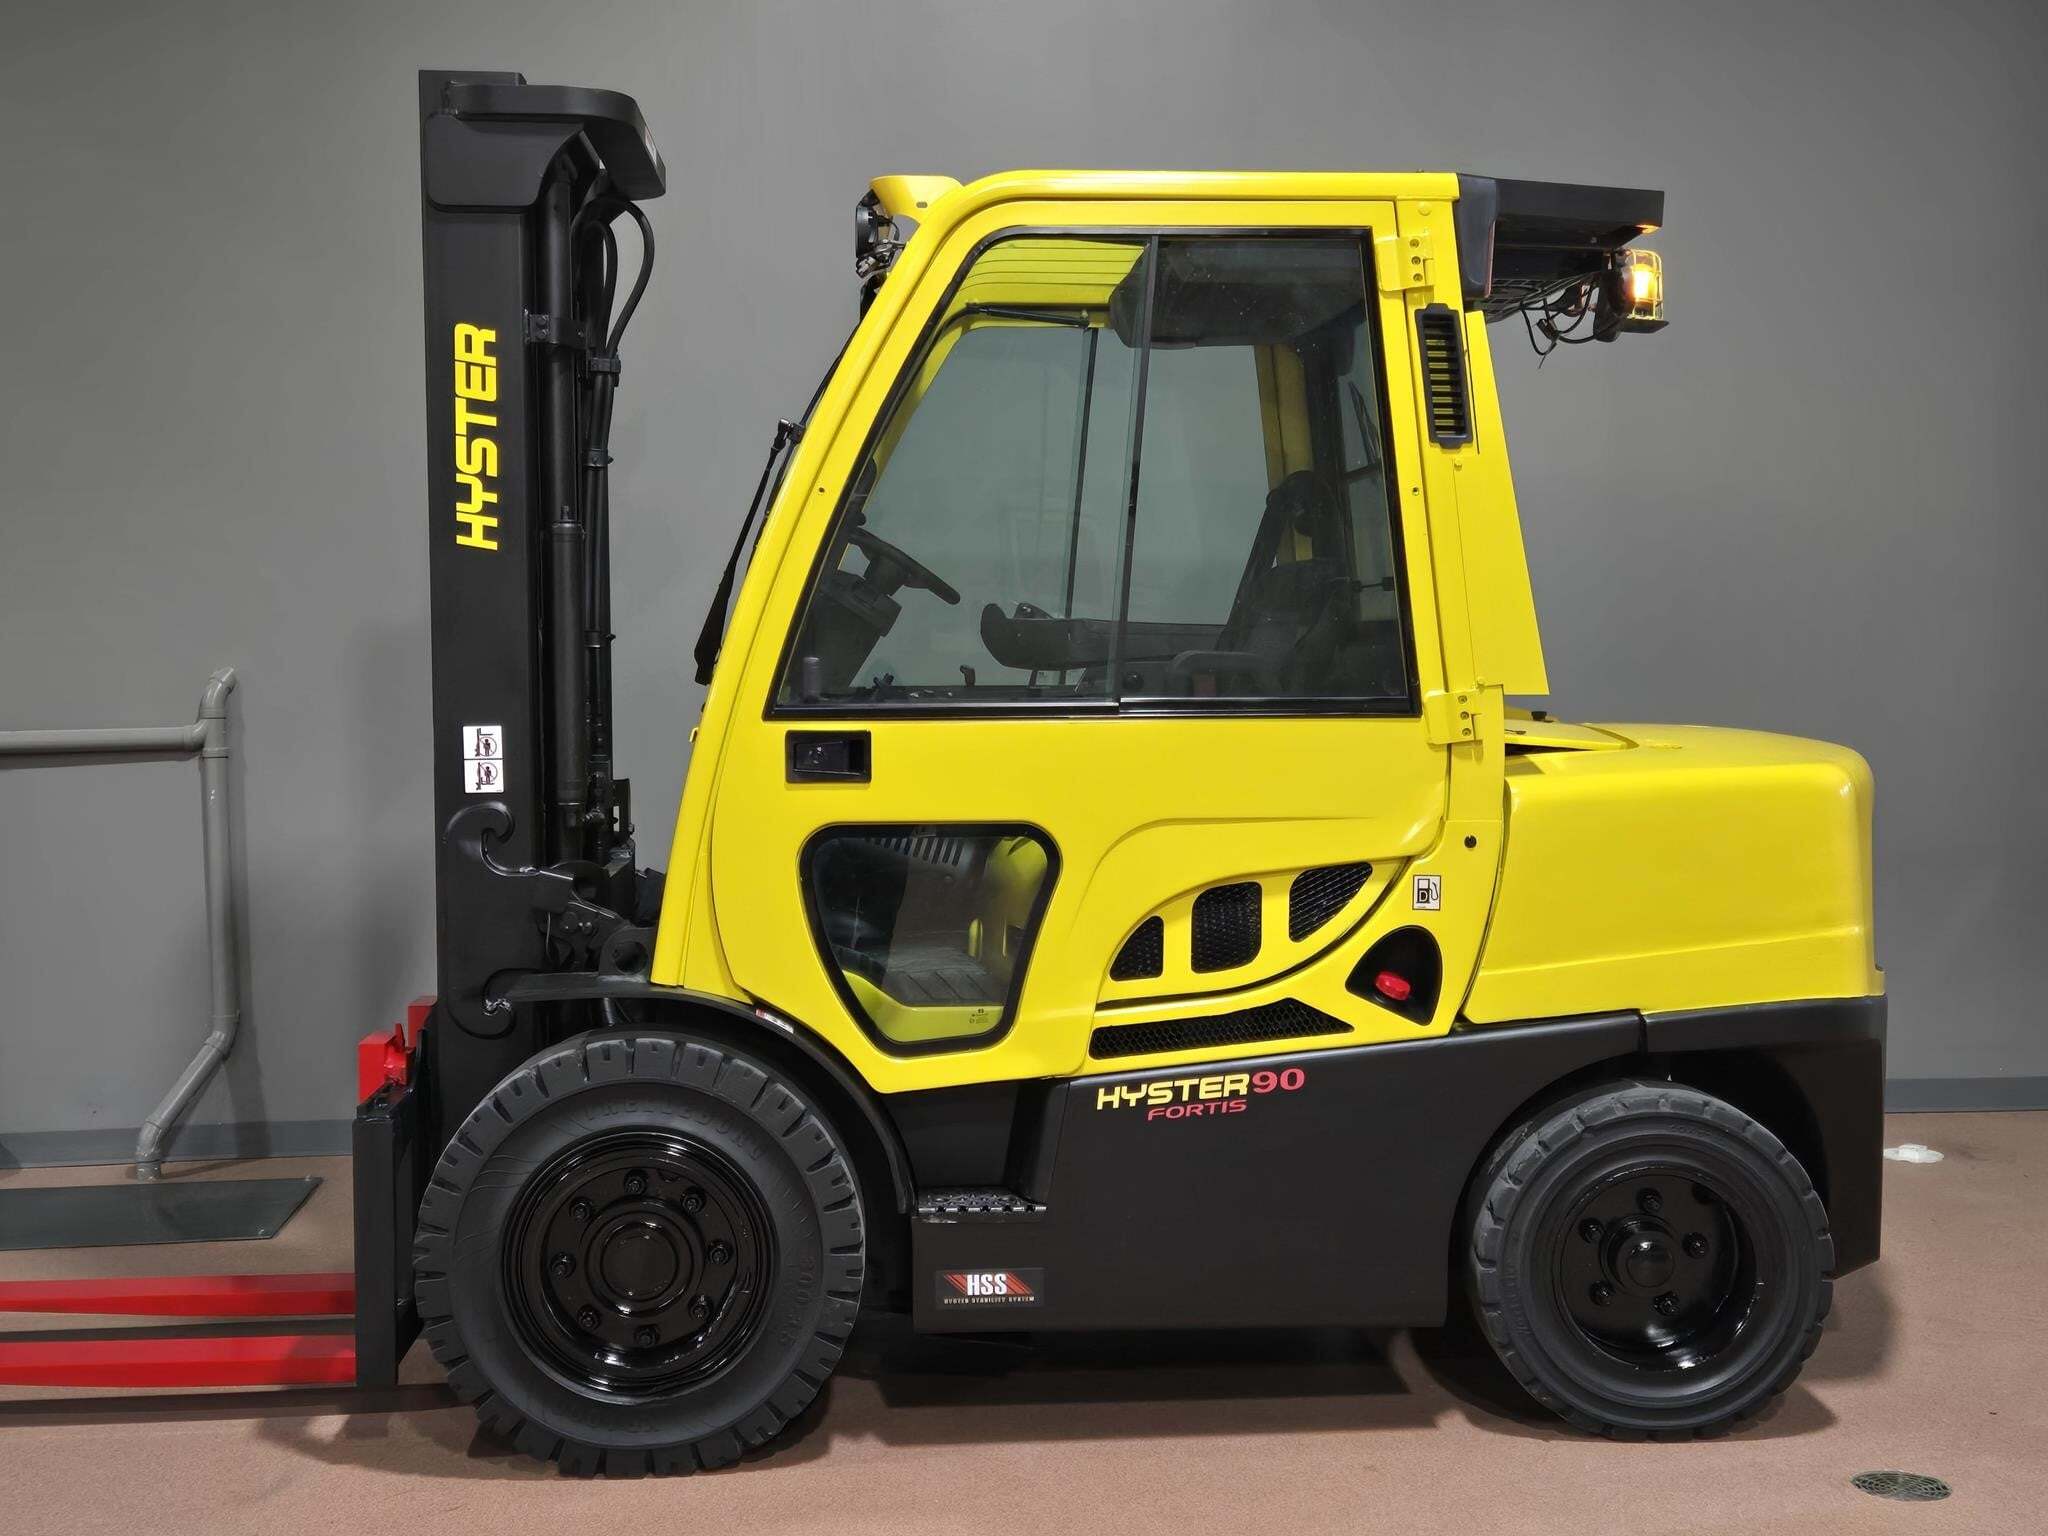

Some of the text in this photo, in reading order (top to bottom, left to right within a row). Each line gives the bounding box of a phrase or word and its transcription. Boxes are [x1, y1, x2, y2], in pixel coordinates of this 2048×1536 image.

[454, 323, 498, 550] HYSTER
[1097, 1068, 1305, 1110] HYSTER 90
[1147, 1099, 1247, 1121] FORTIS
[967, 1274, 1007, 1295] HSS
